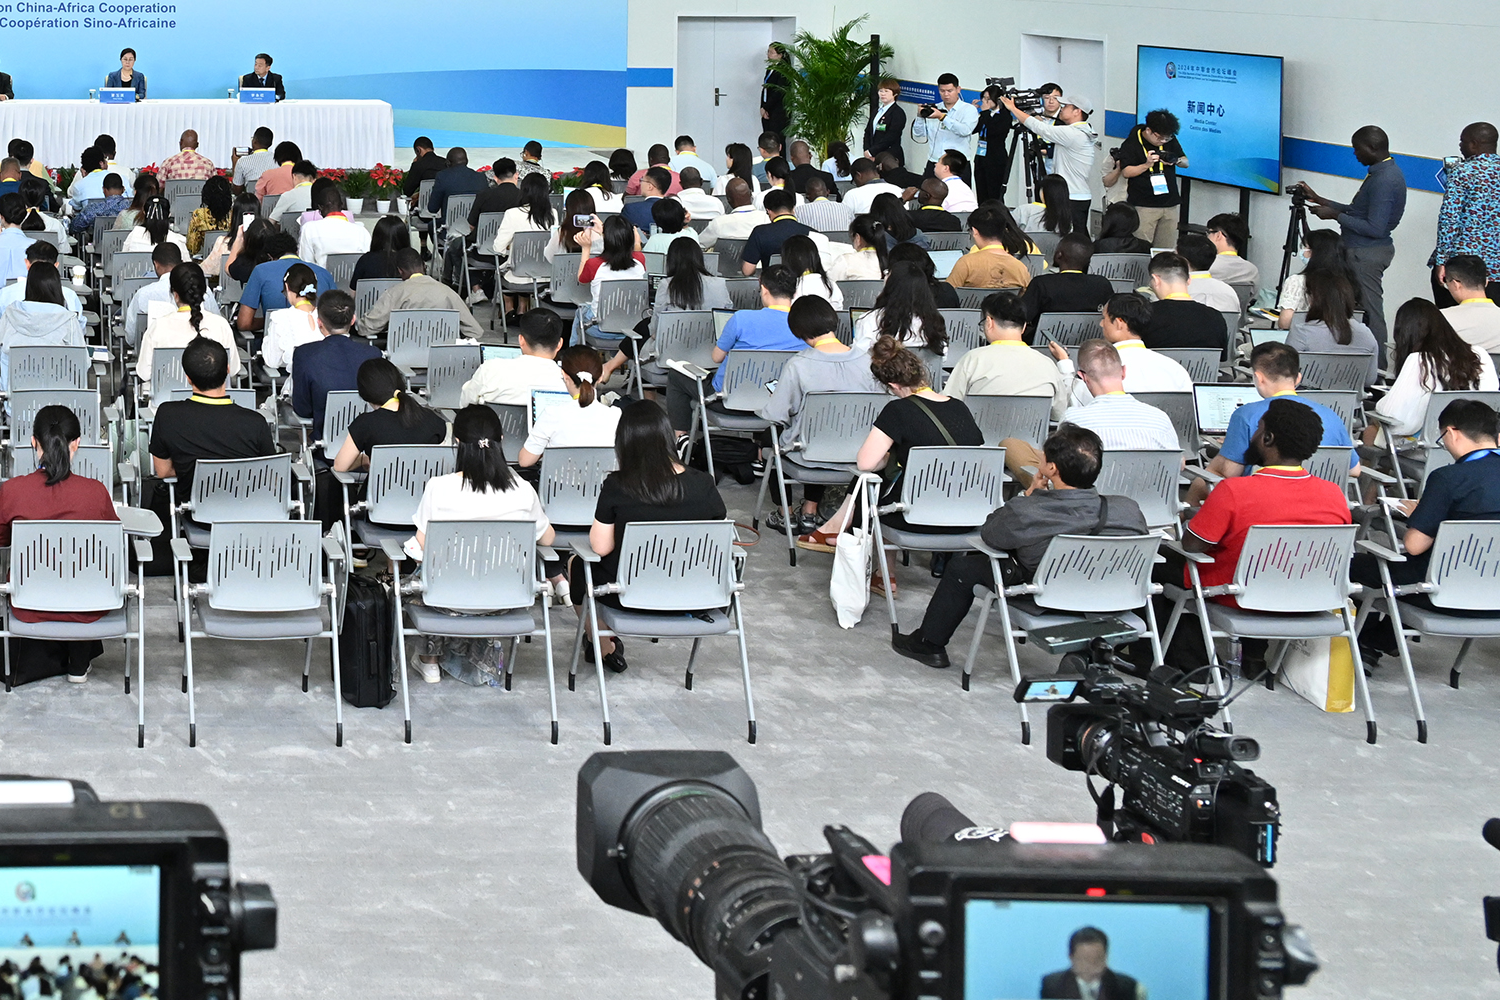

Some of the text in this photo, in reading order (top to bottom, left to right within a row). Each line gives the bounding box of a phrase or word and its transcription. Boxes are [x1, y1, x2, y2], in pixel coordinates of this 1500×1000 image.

[16, 2, 94, 13] China-Africa
[99, 2, 176, 14] Cooperation
[0, 17, 79, 30] Coopération
[84, 17, 176, 28] Sino-Africaine
[1186, 100, 1226, 118] 新闻中心
